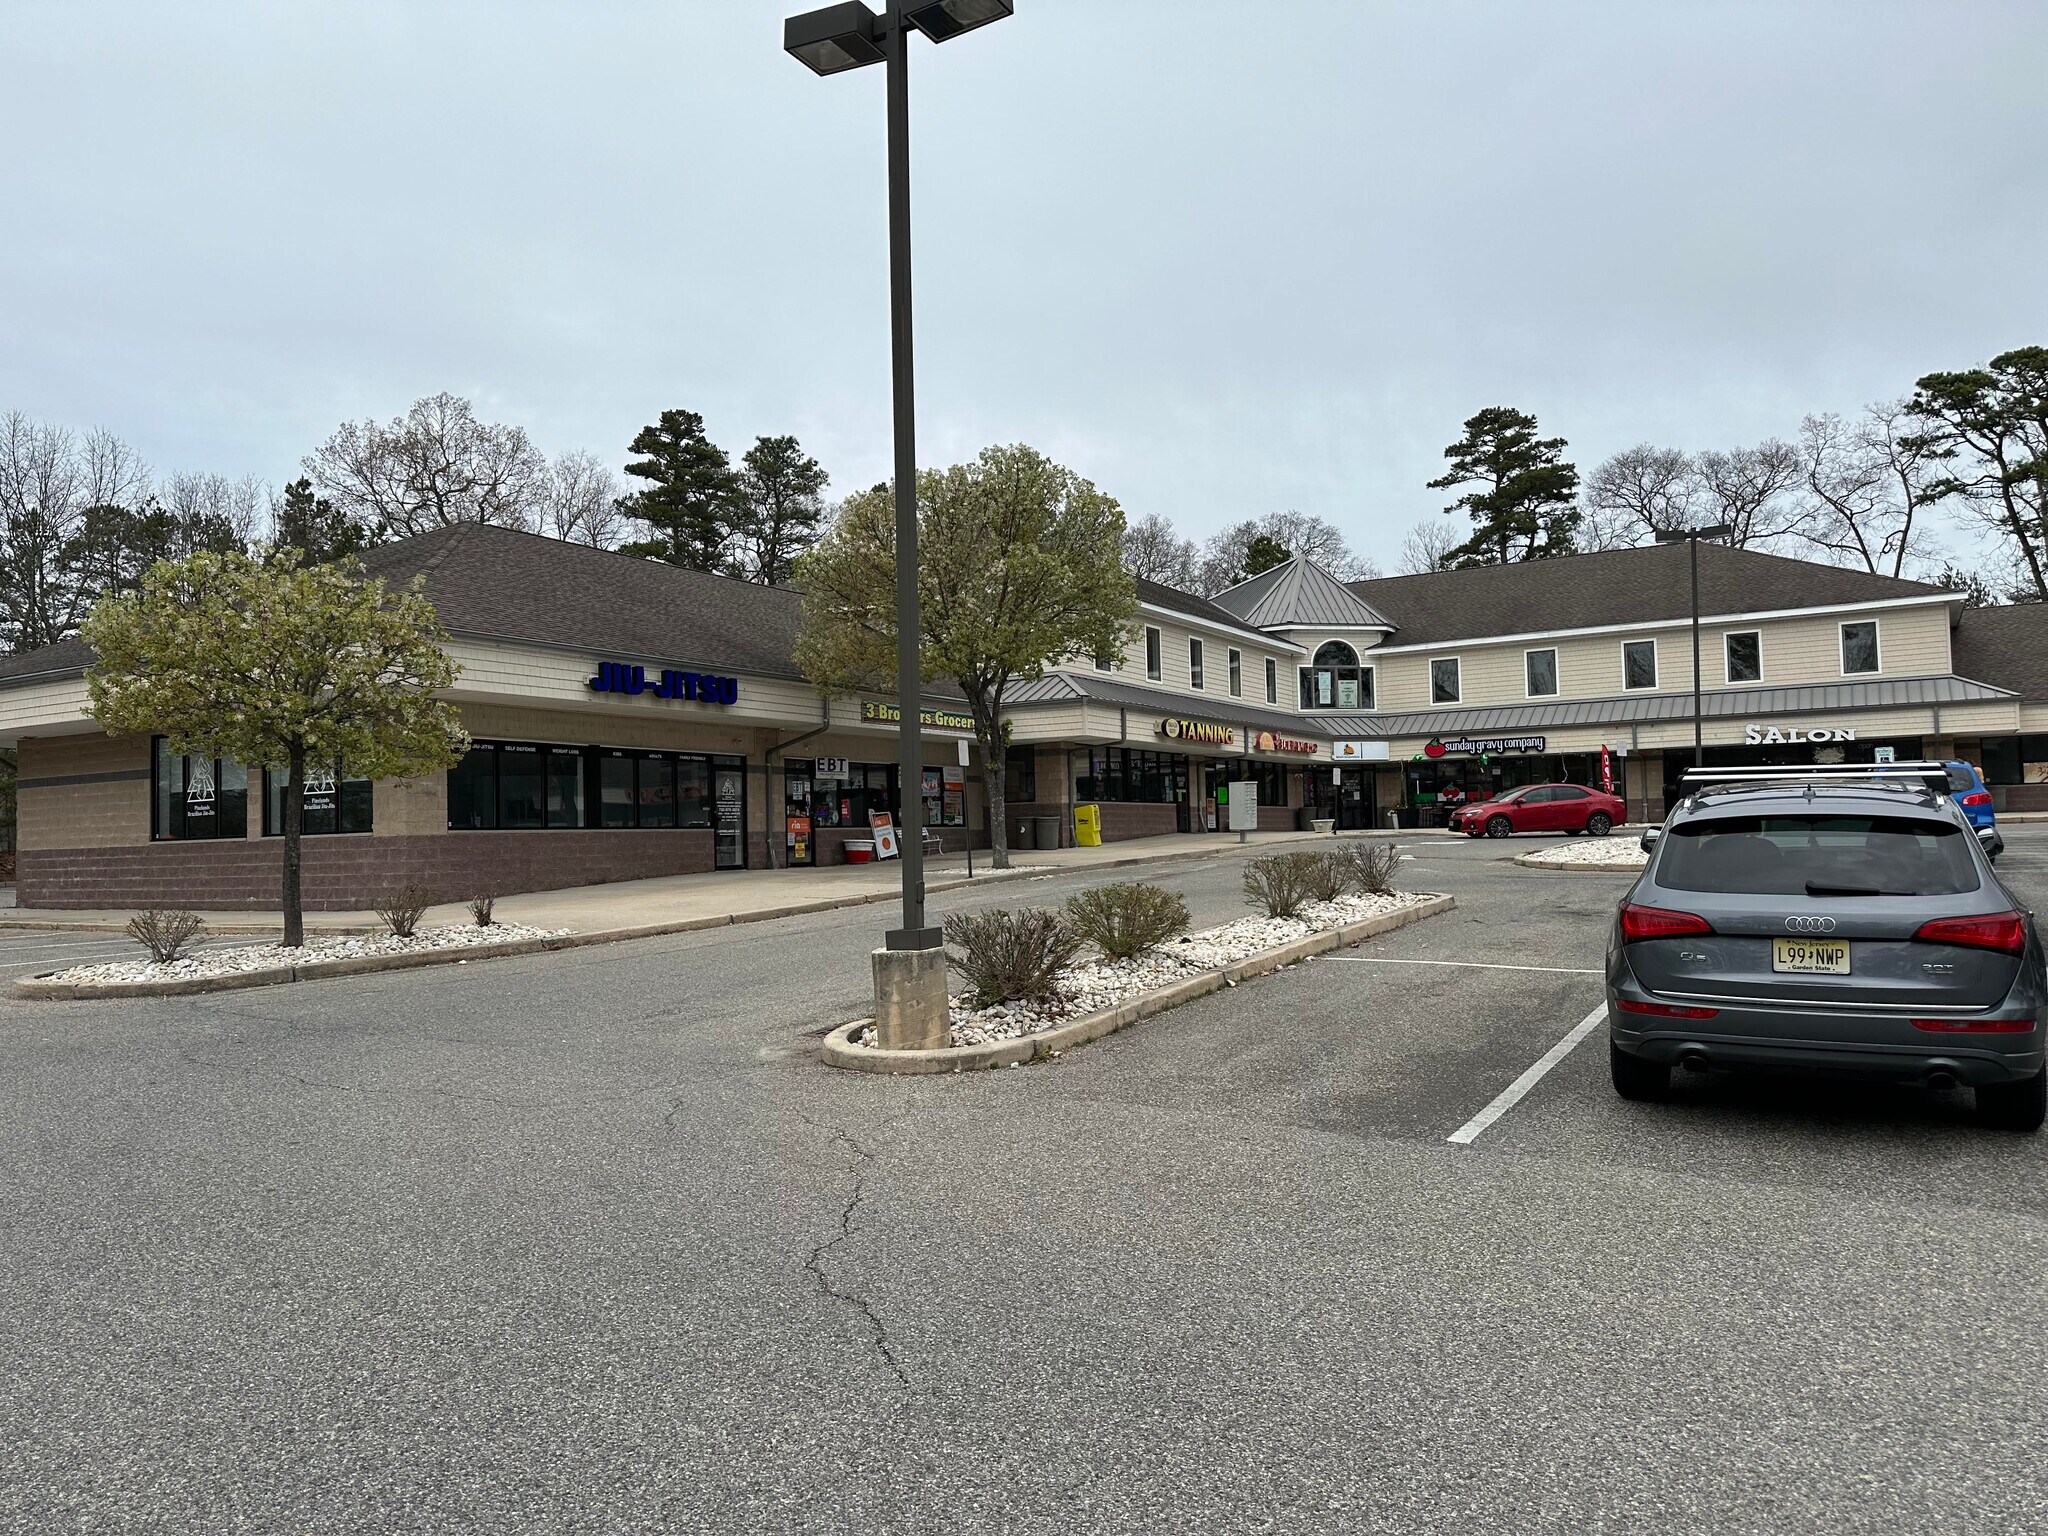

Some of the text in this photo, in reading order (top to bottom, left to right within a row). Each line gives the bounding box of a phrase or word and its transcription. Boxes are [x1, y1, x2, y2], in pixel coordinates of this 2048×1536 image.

[589, 662, 738, 705] JIU-JITSU
[866, 703, 875, 718] 3
[879, 704, 931, 724] Brors
[1180, 720, 1234, 745] TANNING
[1745, 724, 1857, 745] SALON
[1445, 737, 1543, 754] sunday gravy company
[817, 757, 846, 771] EBT
[1808, 940, 1829, 948] Jersey
[1778, 946, 1844, 965] L99 NWP
